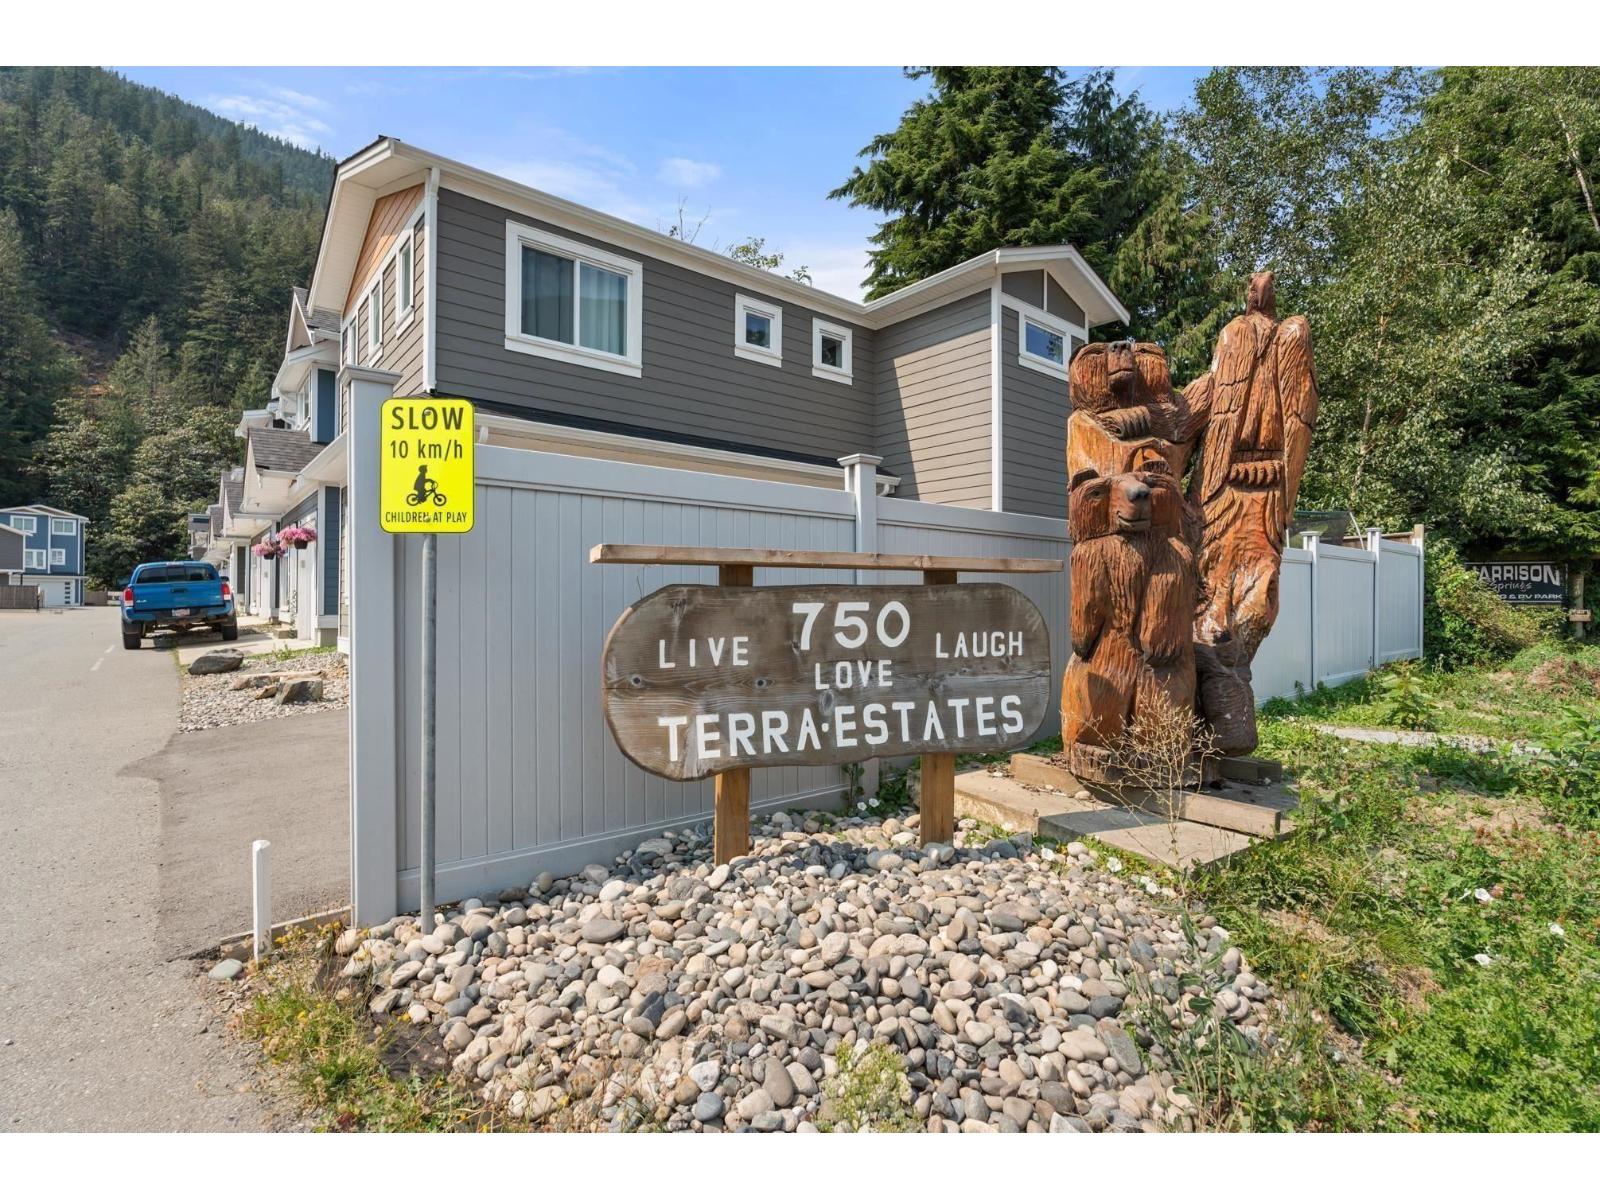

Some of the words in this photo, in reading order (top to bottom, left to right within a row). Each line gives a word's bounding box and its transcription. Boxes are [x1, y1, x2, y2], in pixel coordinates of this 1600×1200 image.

[391, 406, 464, 430] SLOW
[390, 440, 409, 459] 10
[418, 439, 463, 462] km/h
[385, 511, 430, 523] CHILDREN
[433, 511, 443, 523] AT
[446, 511, 467, 523] PLAY
[1473, 565, 1561, 586] ARRISON
[792, 601, 910, 651] 750
[659, 636, 749, 669] LIVE
[935, 631, 1024, 659] LAUGH
[814, 659, 893, 690] LOVE
